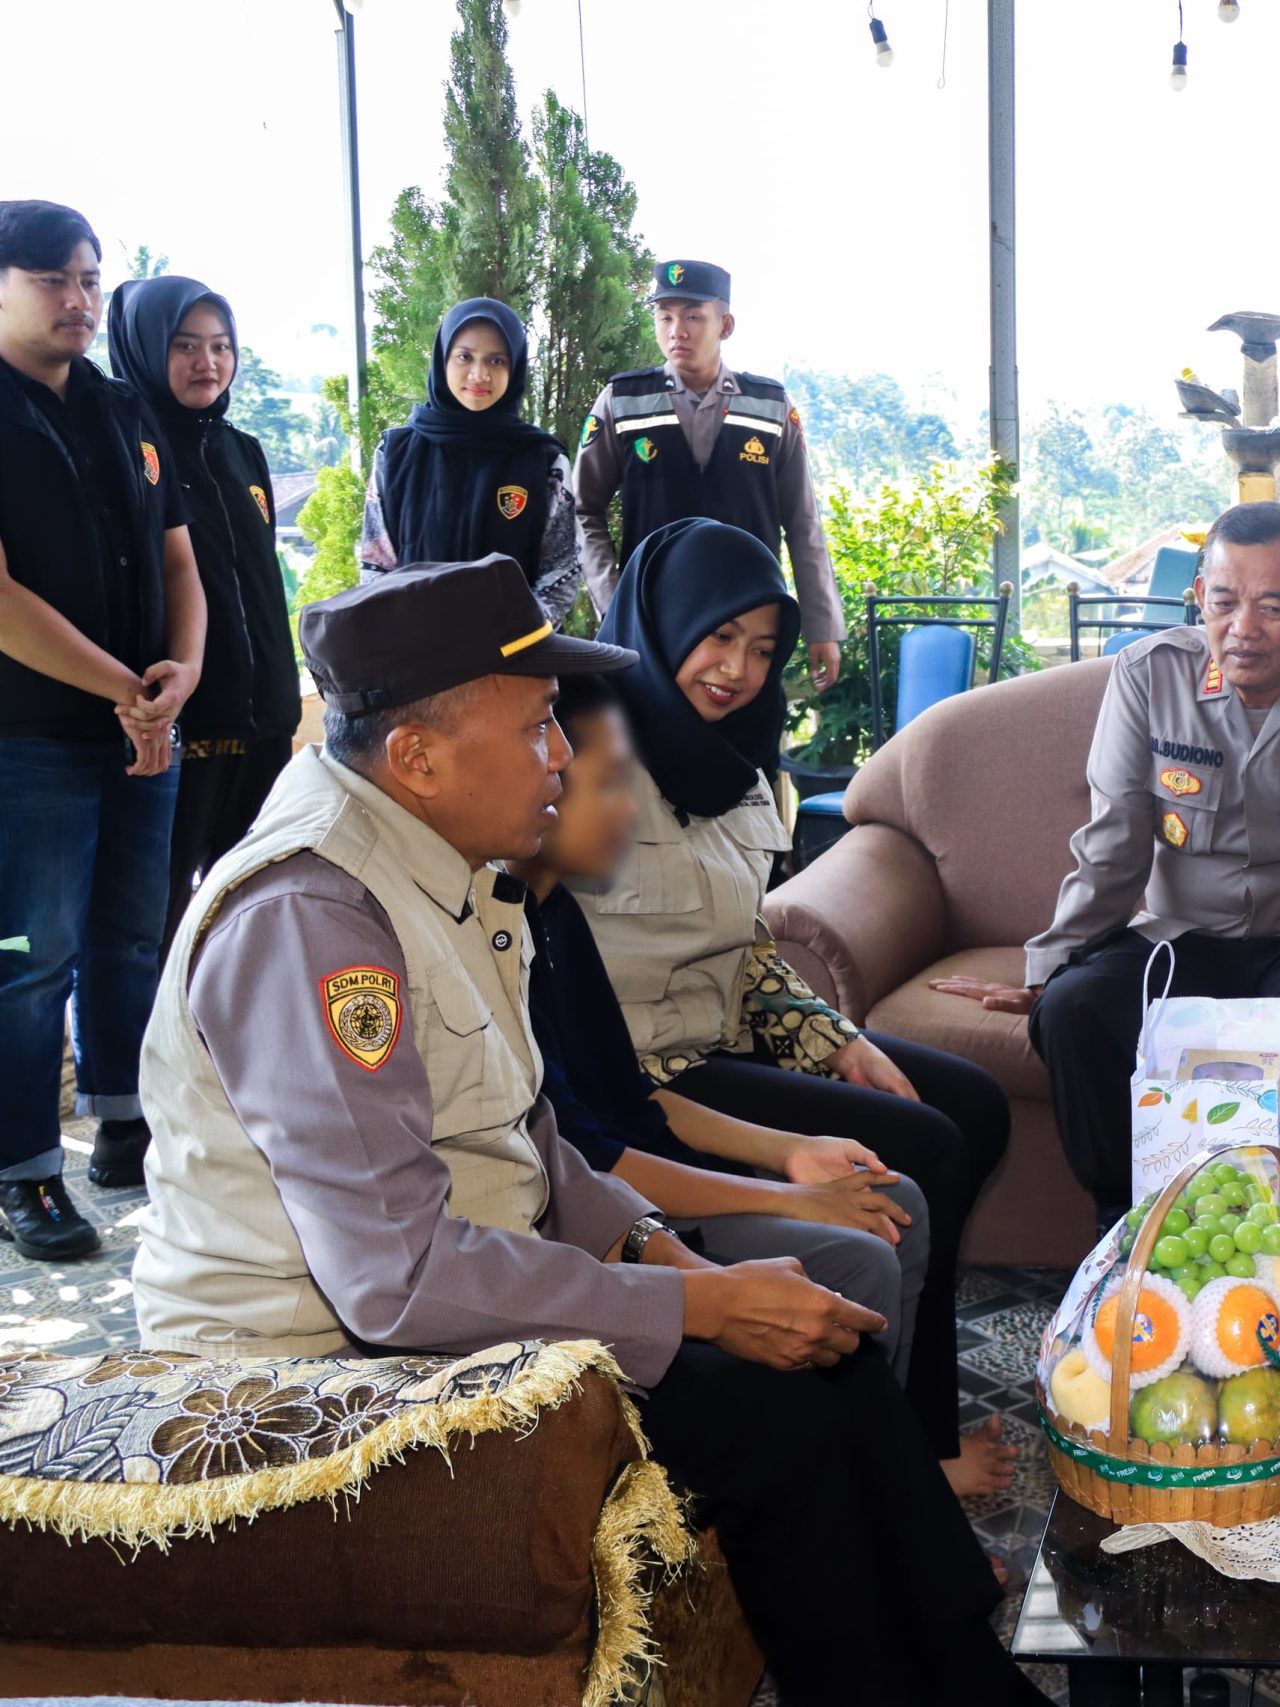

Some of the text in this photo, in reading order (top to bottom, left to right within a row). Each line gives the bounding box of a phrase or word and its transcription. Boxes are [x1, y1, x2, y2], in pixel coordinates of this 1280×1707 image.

[740, 452, 769, 464] POLISI
[332, 974, 391, 992] SDM POLRI
[1116, 1465, 1138, 1478] FRESH
[1192, 1468, 1217, 1482] FRESH
